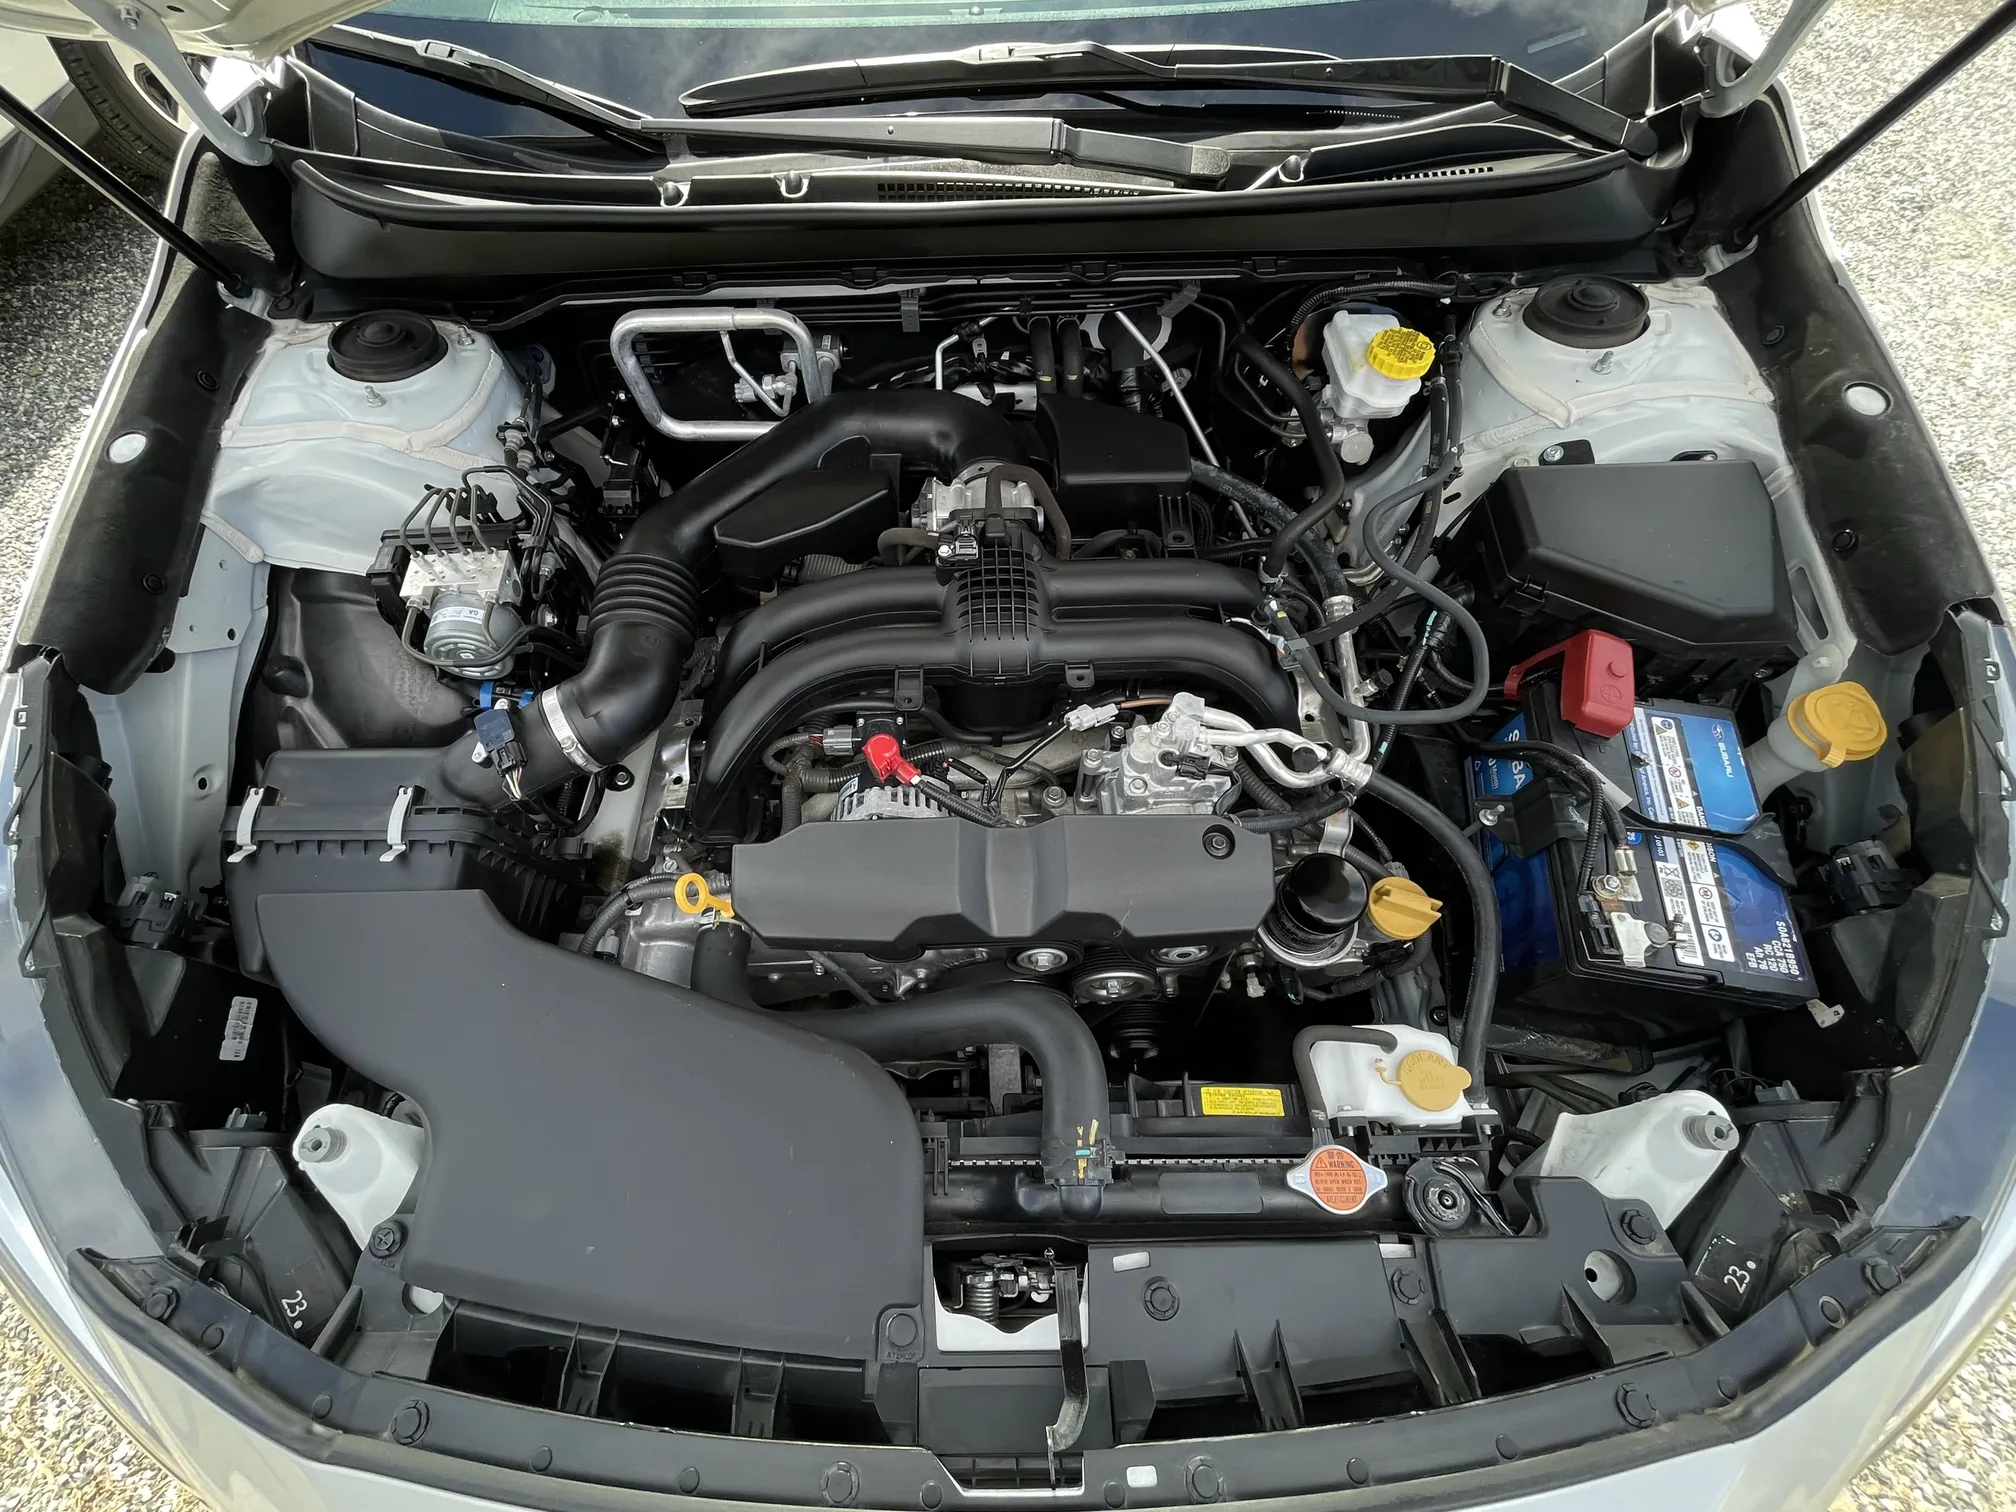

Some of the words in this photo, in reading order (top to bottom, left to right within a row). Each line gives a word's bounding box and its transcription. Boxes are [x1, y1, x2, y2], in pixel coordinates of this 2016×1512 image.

[1508, 729, 1526, 790] SBA
[1718, 742, 1734, 778] SUBARU
[1696, 805, 1708, 829] DANGE
[1705, 842, 1717, 863] ISON
[1753, 946, 1765, 958] Ah
[1763, 943, 1774, 955] RC
[1771, 940, 1784, 956] CCA
[1745, 952, 1758, 968] EFB
[1767, 957, 1779, 972] 120
[1777, 958, 1789, 973] 750
[1328, 1160, 1355, 1169] WARNING
